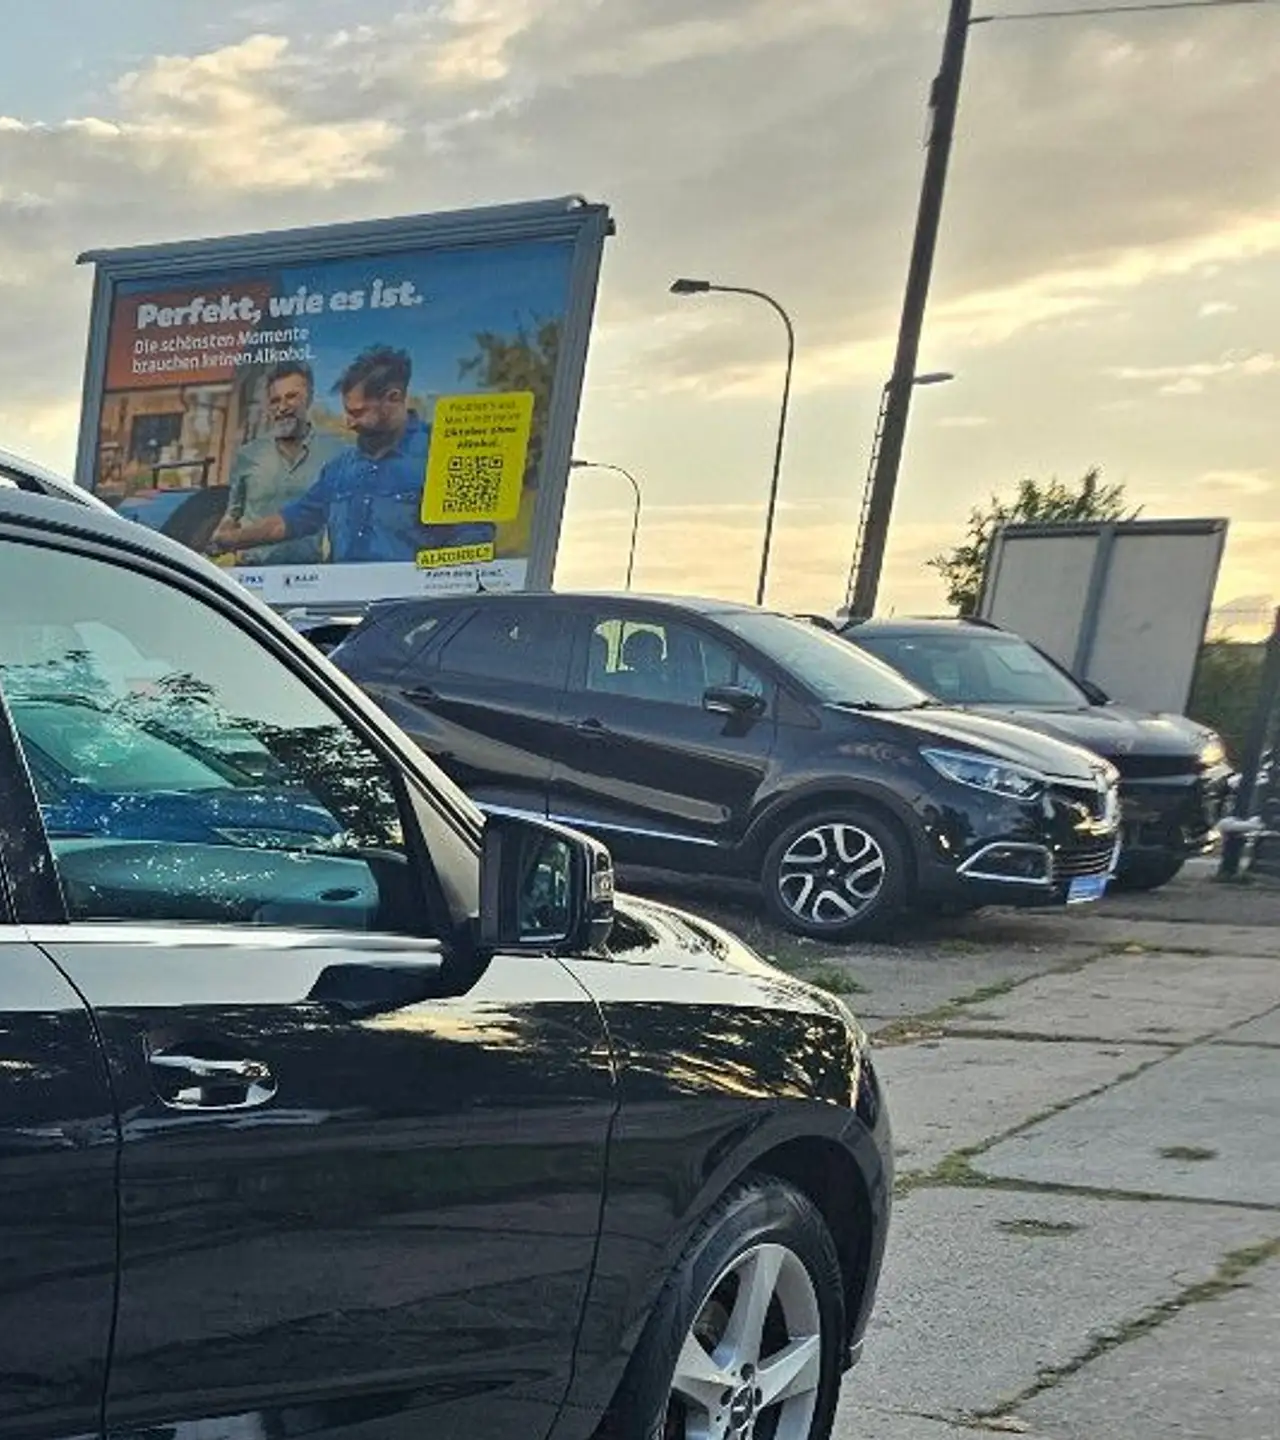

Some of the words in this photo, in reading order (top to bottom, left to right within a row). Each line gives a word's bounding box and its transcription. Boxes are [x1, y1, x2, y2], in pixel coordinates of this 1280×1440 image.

[137, 294, 263, 329] Perfekt,
[268, 286, 324, 318] wie
[328, 289, 365, 312] es
[370, 278, 424, 308] ist.
[134, 339, 158, 356] Die
[236, 327, 310, 347] Momente
[132, 354, 200, 375] brauchen
